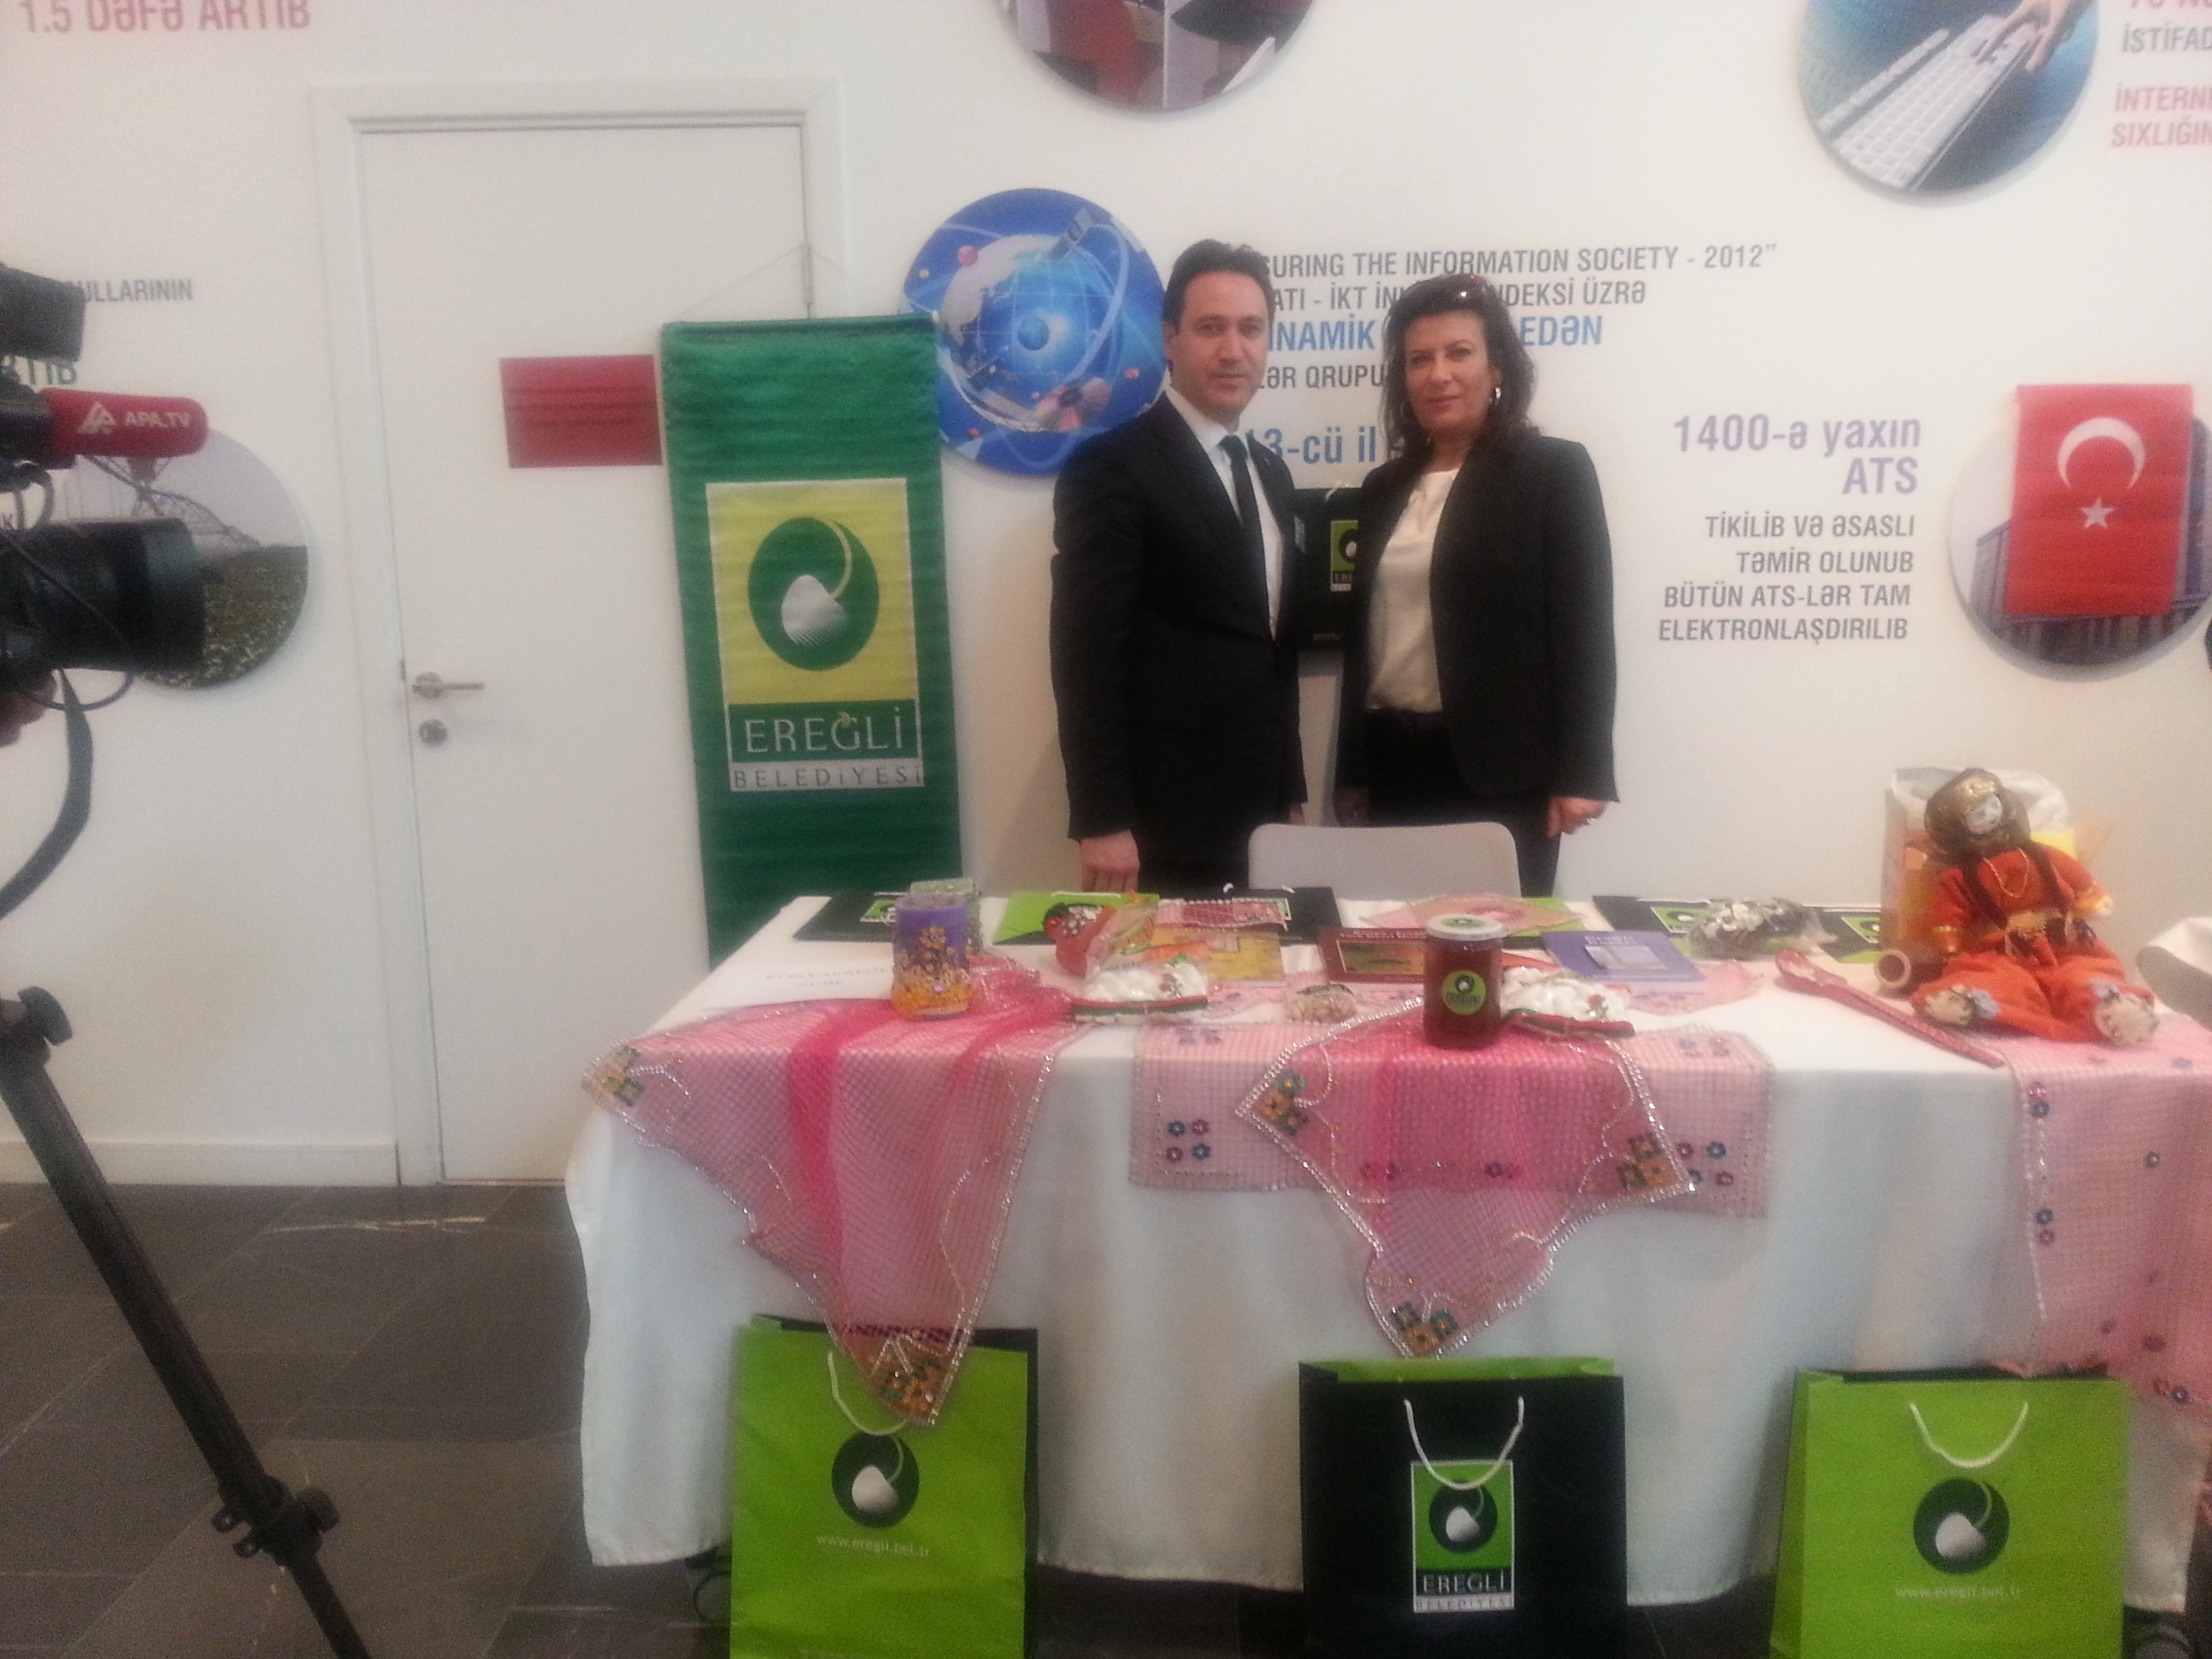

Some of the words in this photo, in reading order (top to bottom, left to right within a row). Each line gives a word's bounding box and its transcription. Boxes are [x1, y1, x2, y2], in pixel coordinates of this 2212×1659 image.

[1353, 251, 1397, 276] THE
[1405, 248, 1569, 275] INFORMATION
[1577, 246, 1679, 272] SOCIETY
[1330, 282, 1367, 310] İKT
[1582, 277, 1646, 306] ÜZRƏ
[1357, 426, 1376, 463] il
[1673, 413, 1808, 452] 1400-ə
[1822, 417, 1921, 458] yaxın
[1841, 456, 1919, 495] ATS
[1705, 511, 1785, 538] TİKİLİB
[1794, 515, 1824, 538] VƏ
[1832, 514, 1915, 537] ƏSASLI
[1736, 547, 1810, 573] TƏMİR
[1819, 550, 1914, 574] OLUNUB
[1664, 581, 1744, 608] BÜTÜN
[1750, 584, 1851, 607] ATS-LƏR
[1860, 584, 1911, 607] TAM
[1658, 617, 1908, 646] ELEKTRONLAŞDIRILIB
[745, 707, 903, 753] EREĞLİ
